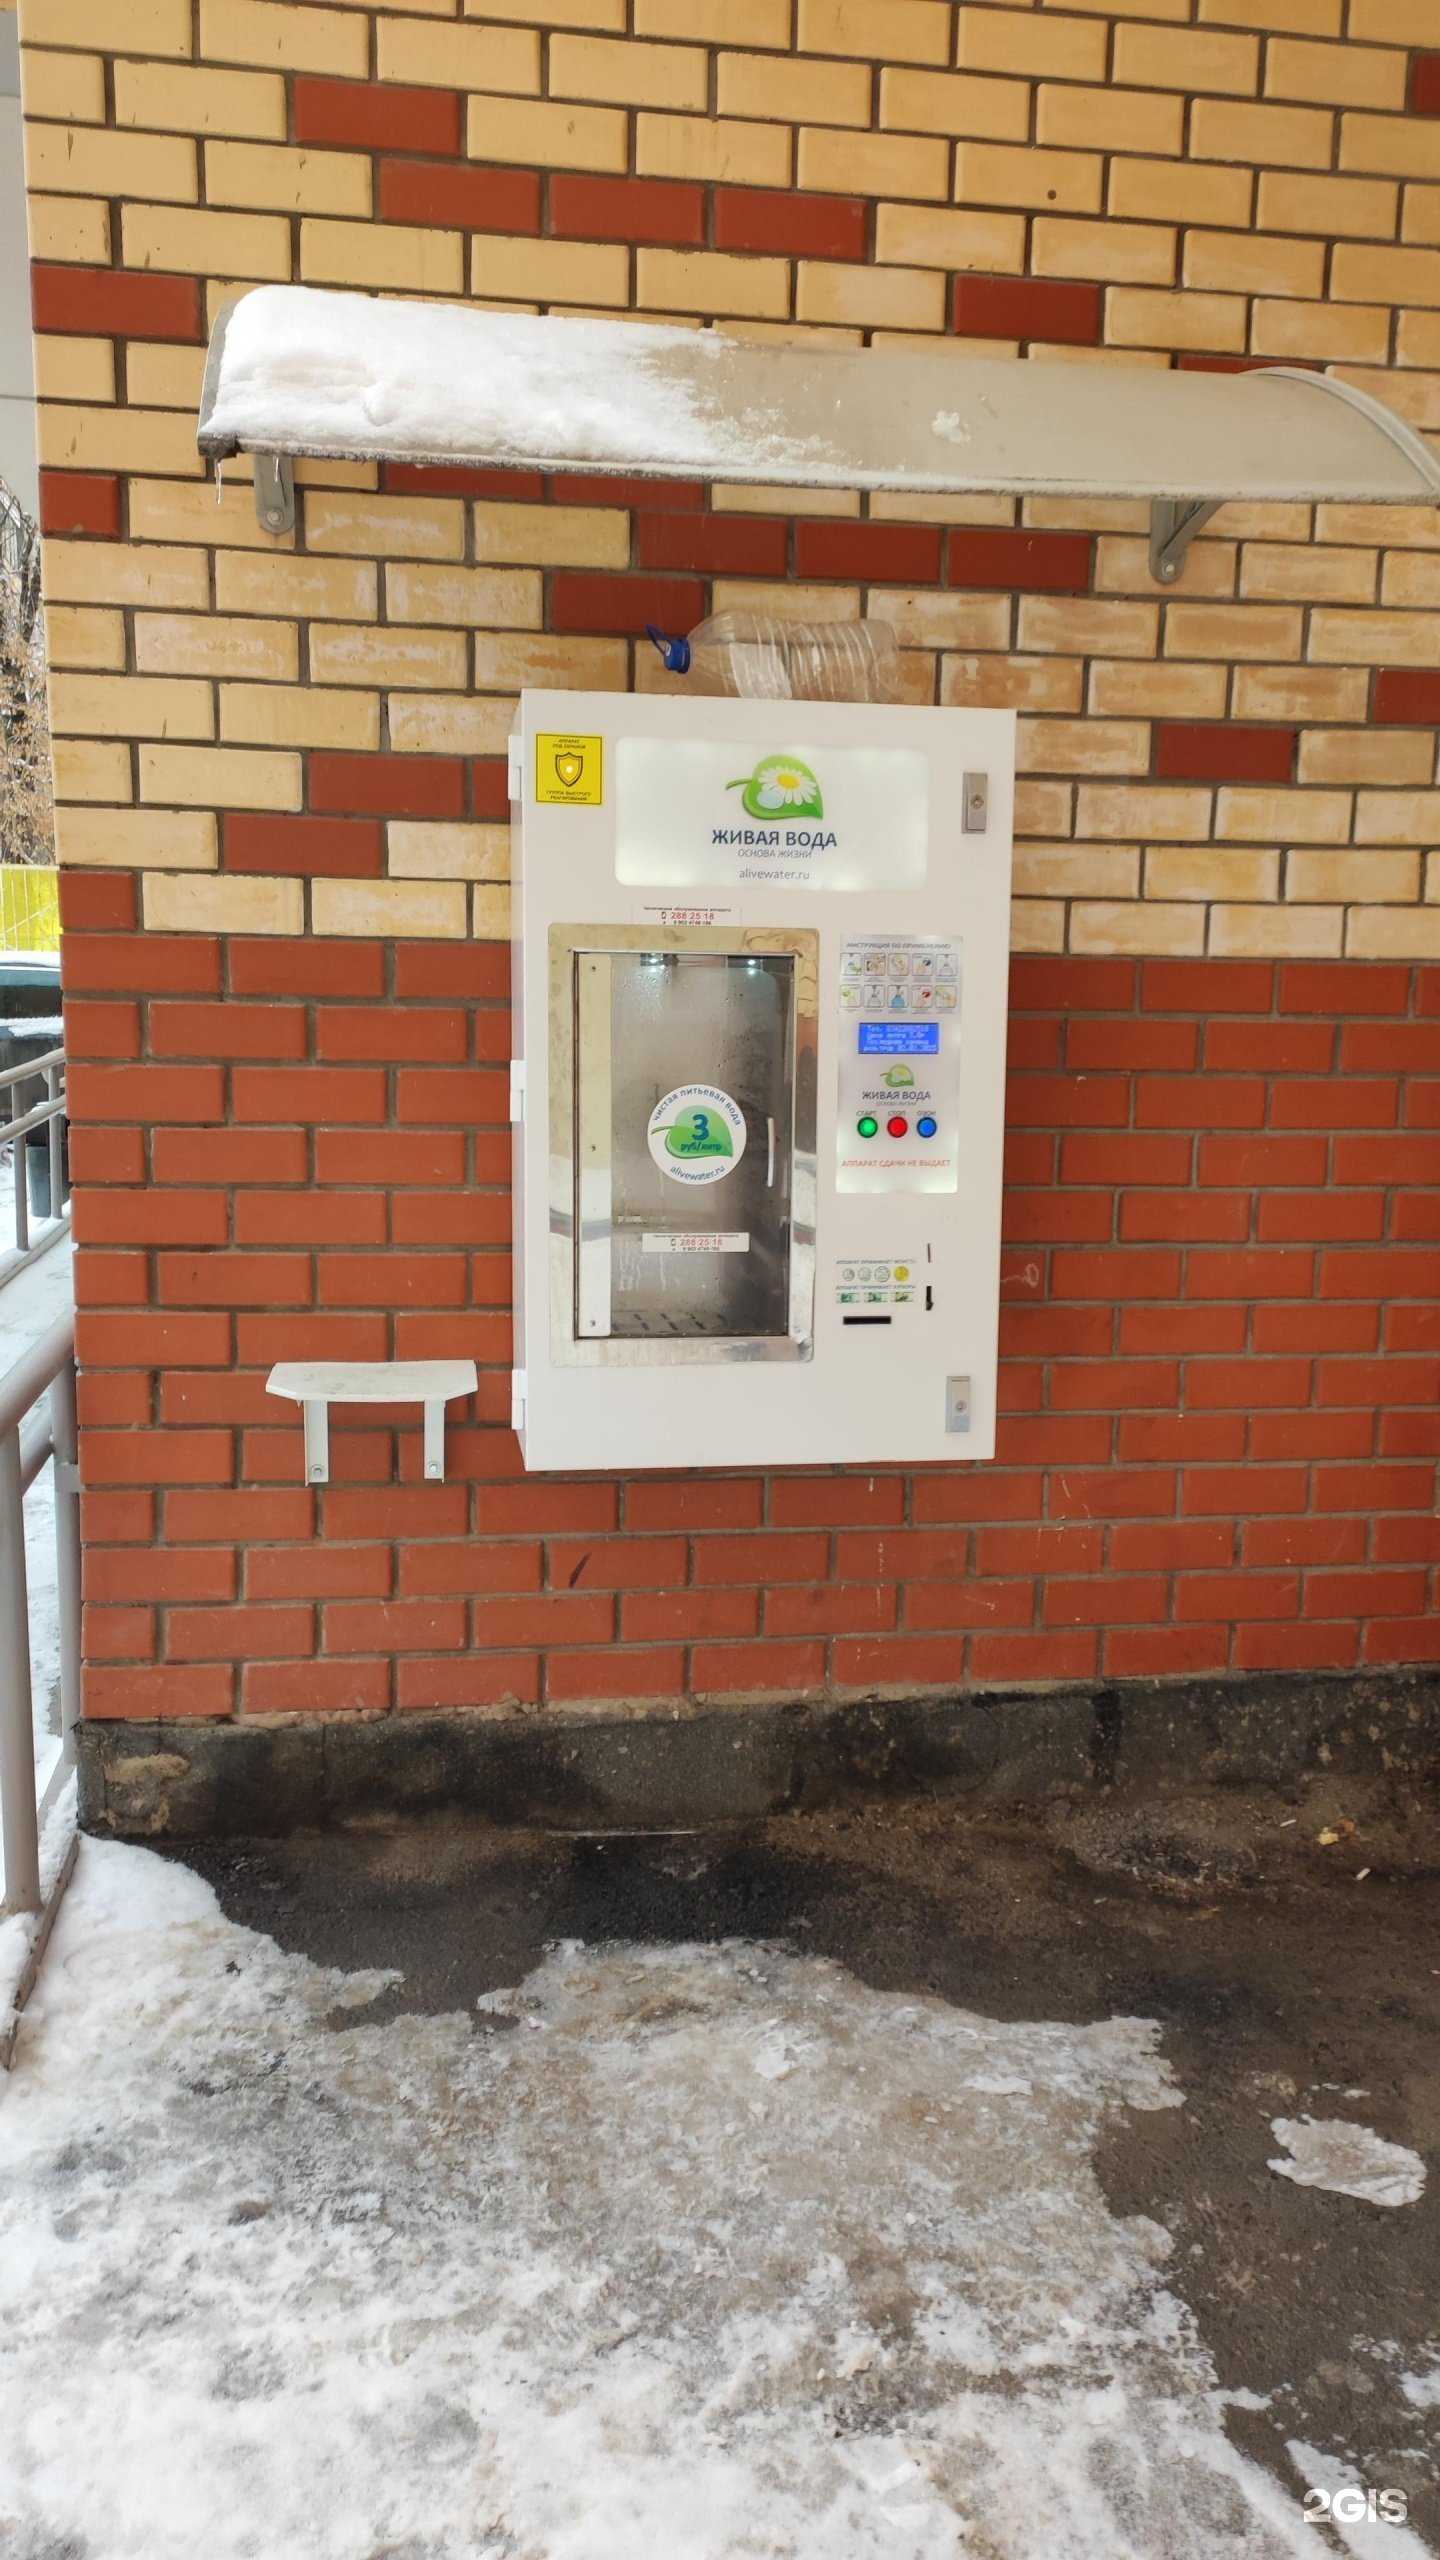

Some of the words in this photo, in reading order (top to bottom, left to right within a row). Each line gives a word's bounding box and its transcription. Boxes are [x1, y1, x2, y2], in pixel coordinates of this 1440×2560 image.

[712, 829, 779, 845] ЖИВАЯ
[786, 831, 837, 850] ВОДА
[738, 848, 775, 858] ОСНОВА
[777, 849, 812, 859] ЖИЗНИ
[739, 868, 810, 880] alivewater.ru
[671, 911, 687, 920] 288
[690, 912, 701, 920] 25
[704, 912, 714, 920] 18
[862, 1090, 900, 1100] ЖИВАЯ
[902, 1091, 931, 1102] ВОДА
[680, 1087, 726, 1103] питьевая
[725, 1102, 741, 1126] вода
[692, 1114, 709, 1141] 3
[879, 1160, 905, 1168] СДАЧИ
[919, 1160, 951, 1168] ВЫДАЕТ
[699, 1238, 709, 1246] 25
